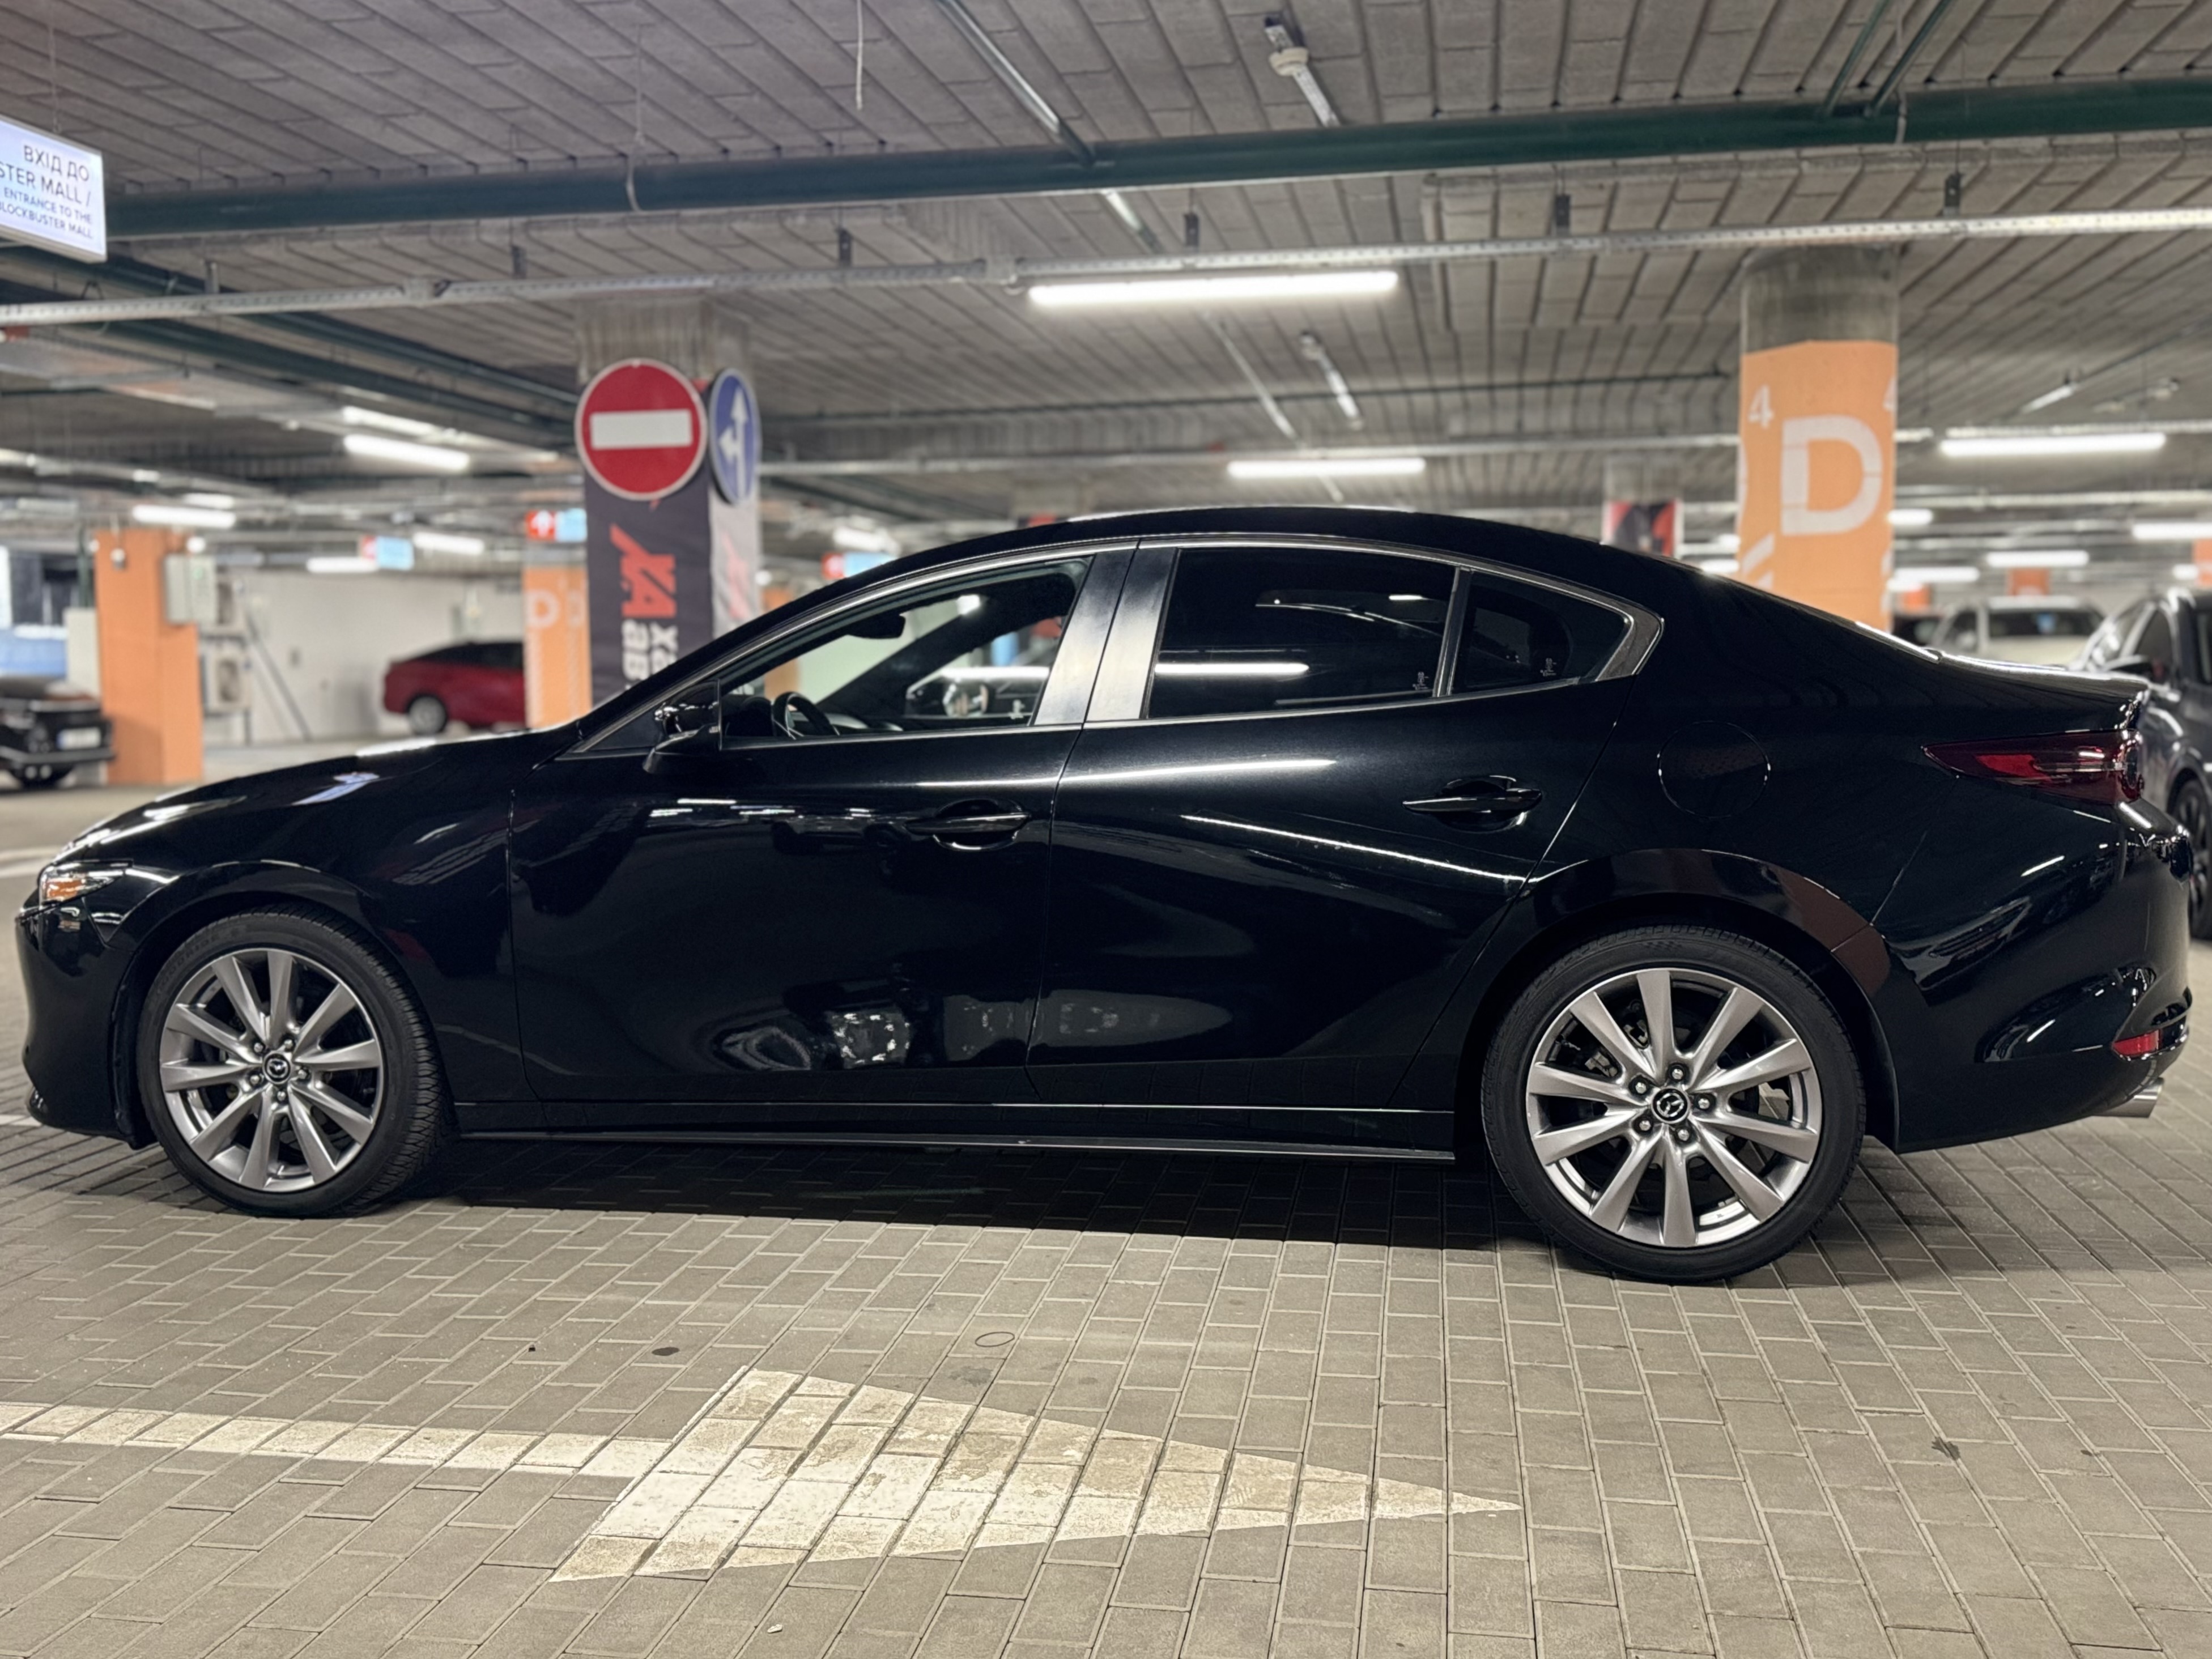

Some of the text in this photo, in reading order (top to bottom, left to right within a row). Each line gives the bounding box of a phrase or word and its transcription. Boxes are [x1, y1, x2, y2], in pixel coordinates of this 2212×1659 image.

[24, 145, 89, 181] ВХІД ДО
[4, 187, 91, 224] ENTRANCE TO THE
[41, 176, 82, 205] MALL
[69, 222, 93, 239] MALL
[1748, 384, 1774, 429] 4
[1780, 414, 1883, 536] D
